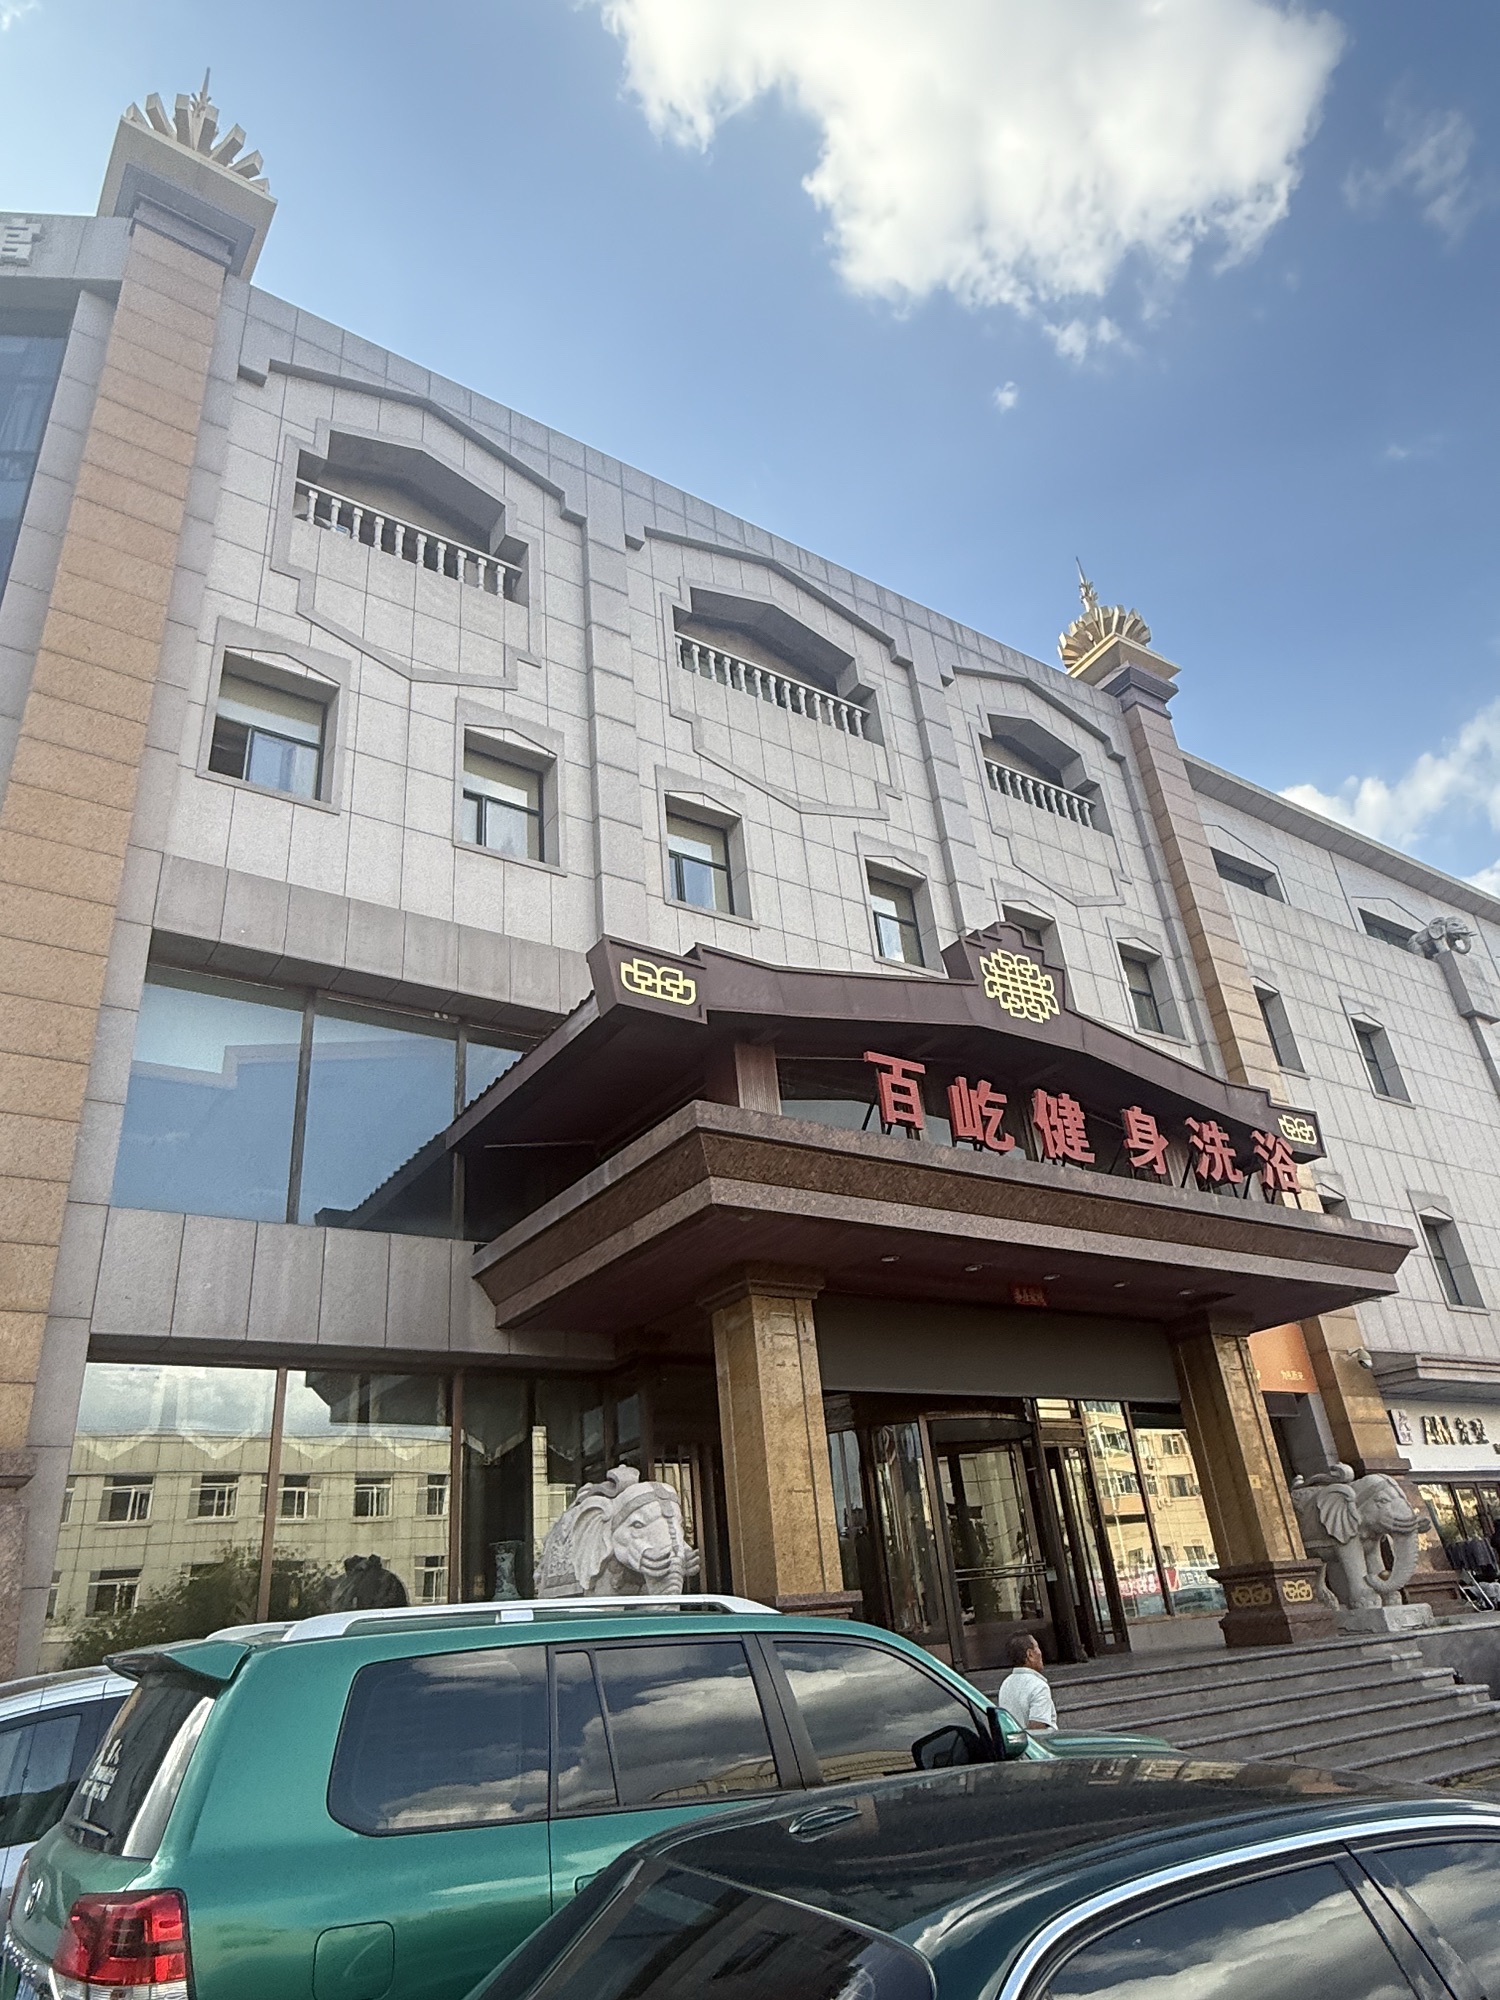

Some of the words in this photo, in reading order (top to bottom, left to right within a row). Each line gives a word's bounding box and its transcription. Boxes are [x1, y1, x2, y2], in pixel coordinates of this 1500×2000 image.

[863, 1050, 1302, 1194] 百屹健身洗浴
